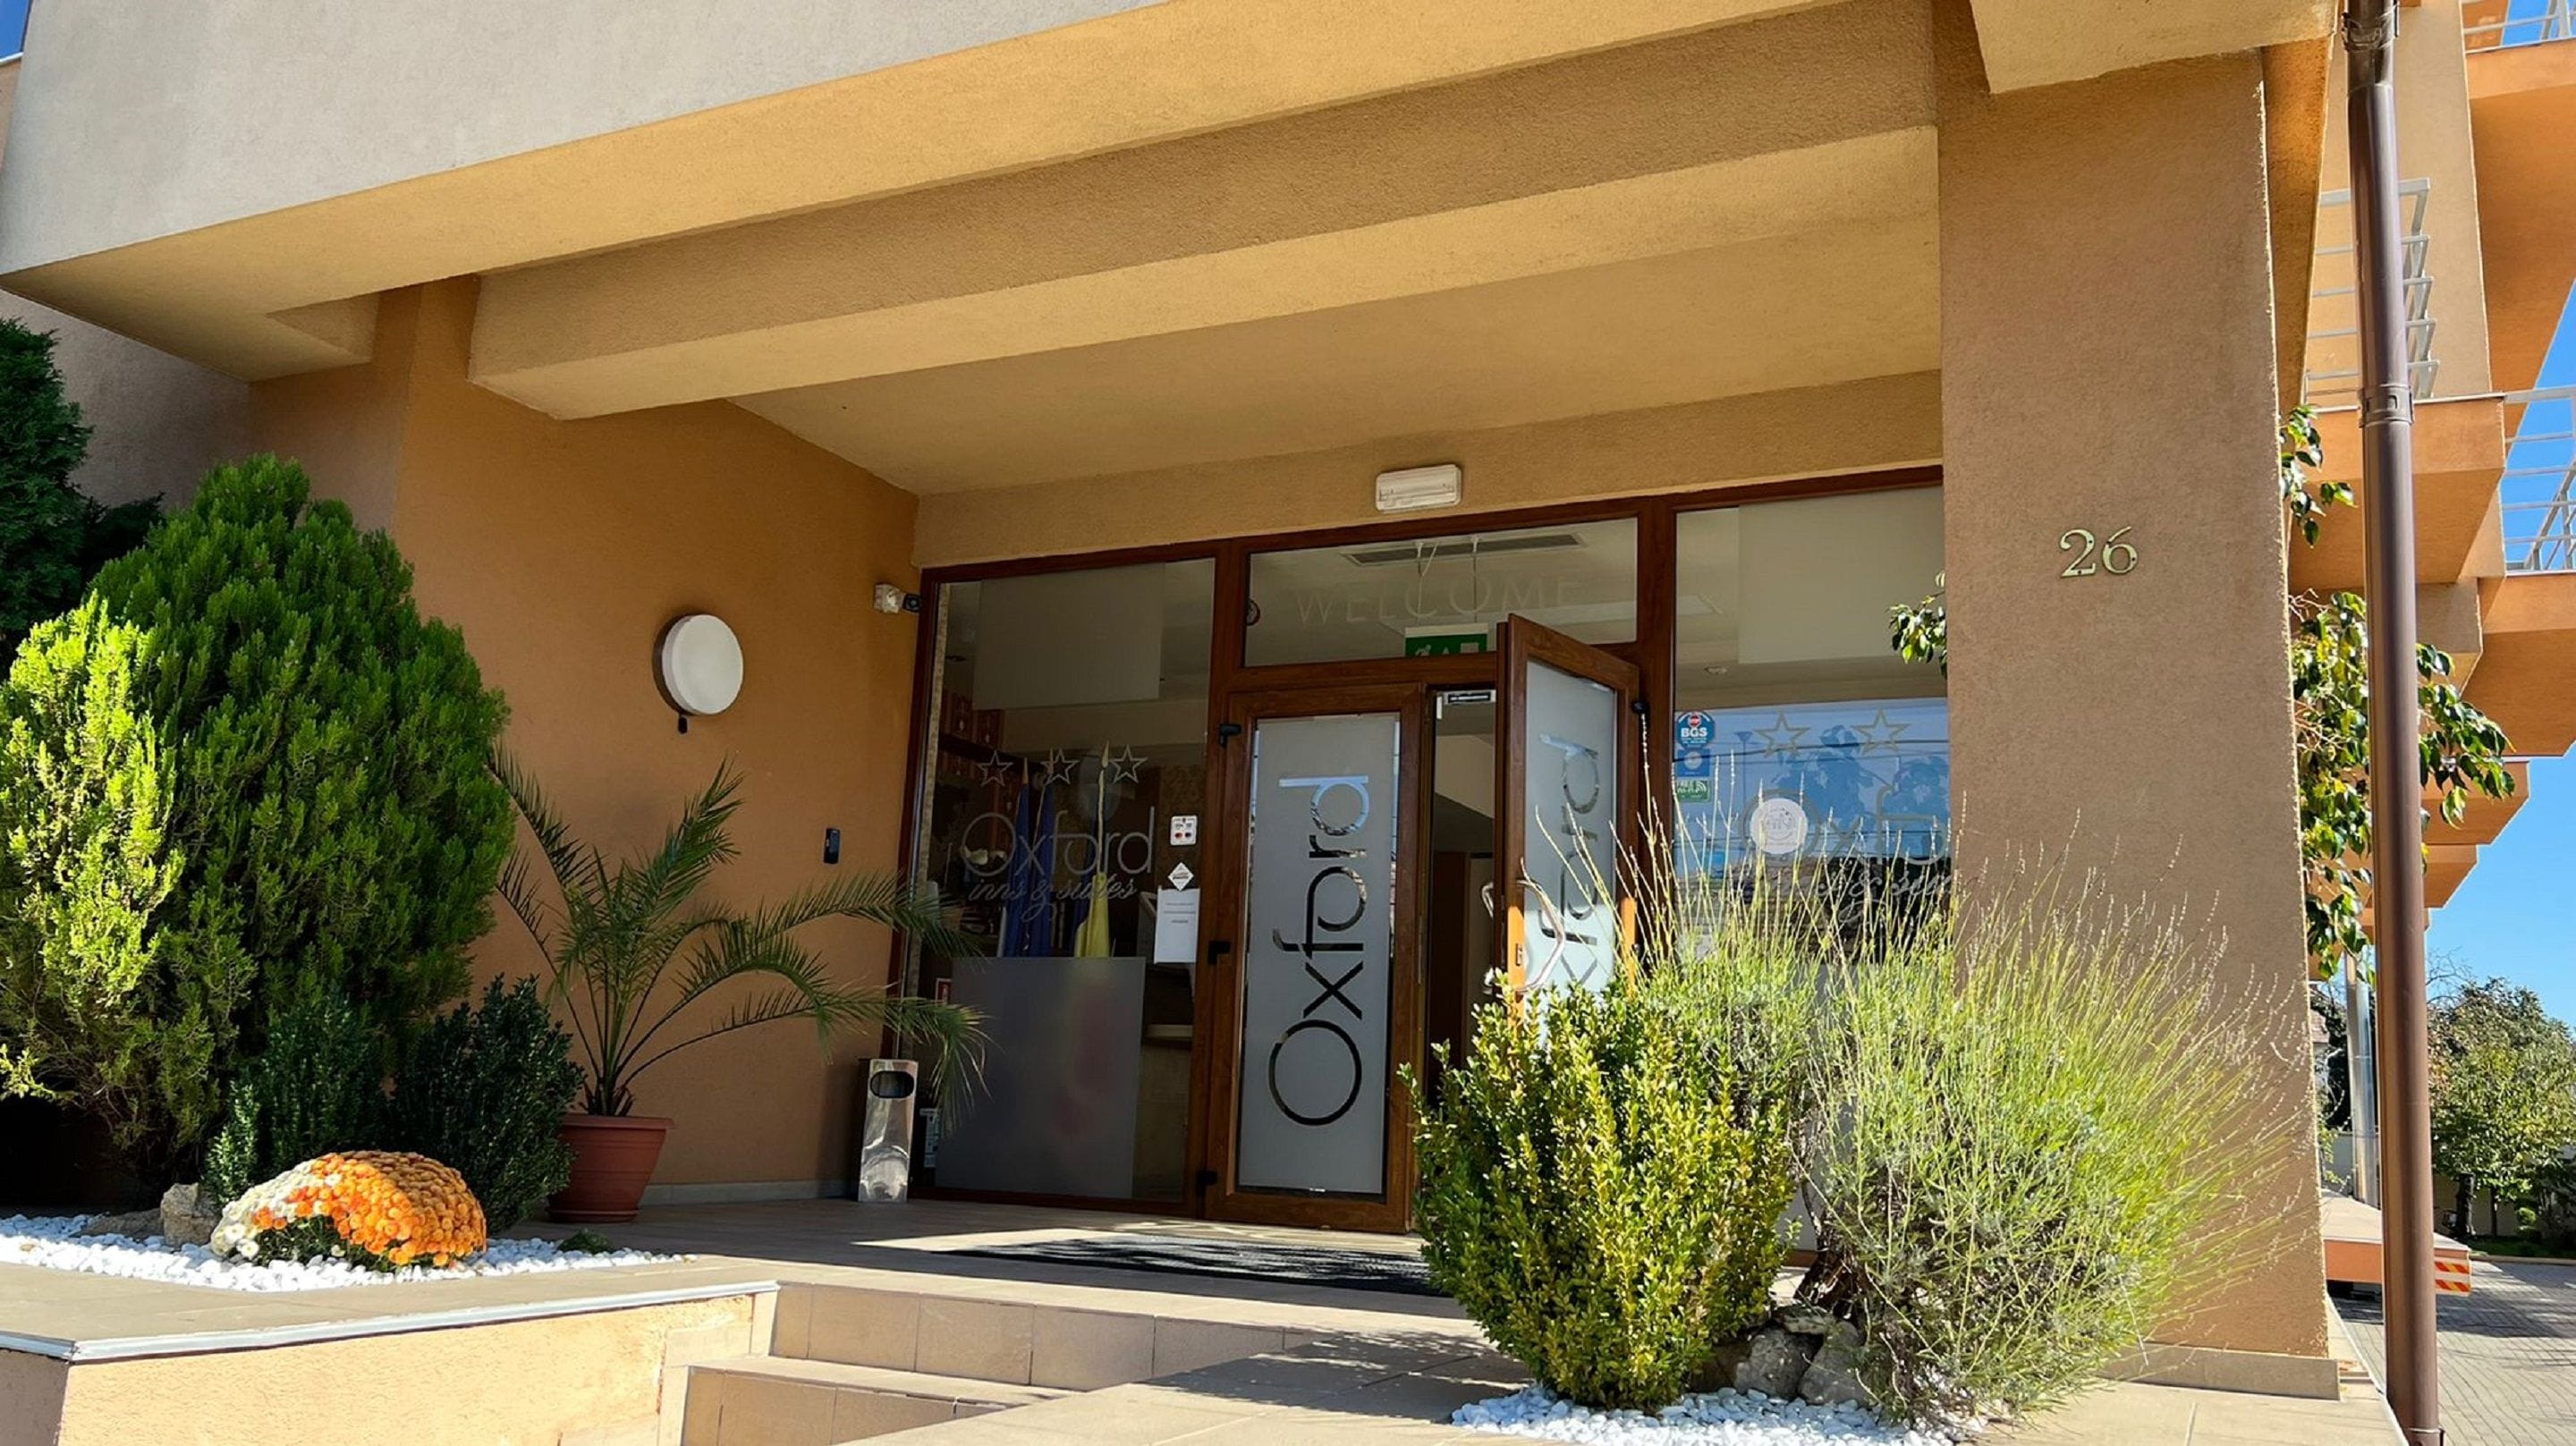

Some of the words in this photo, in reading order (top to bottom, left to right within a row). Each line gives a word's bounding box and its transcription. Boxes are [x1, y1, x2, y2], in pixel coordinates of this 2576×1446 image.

[2060, 526, 2137, 578] 26
[1295, 574, 1576, 624] WELCOME
[1681, 727, 1707, 738] BGS
[962, 806, 1156, 876] Oxford
[1268, 774, 1369, 1126] Oxford
